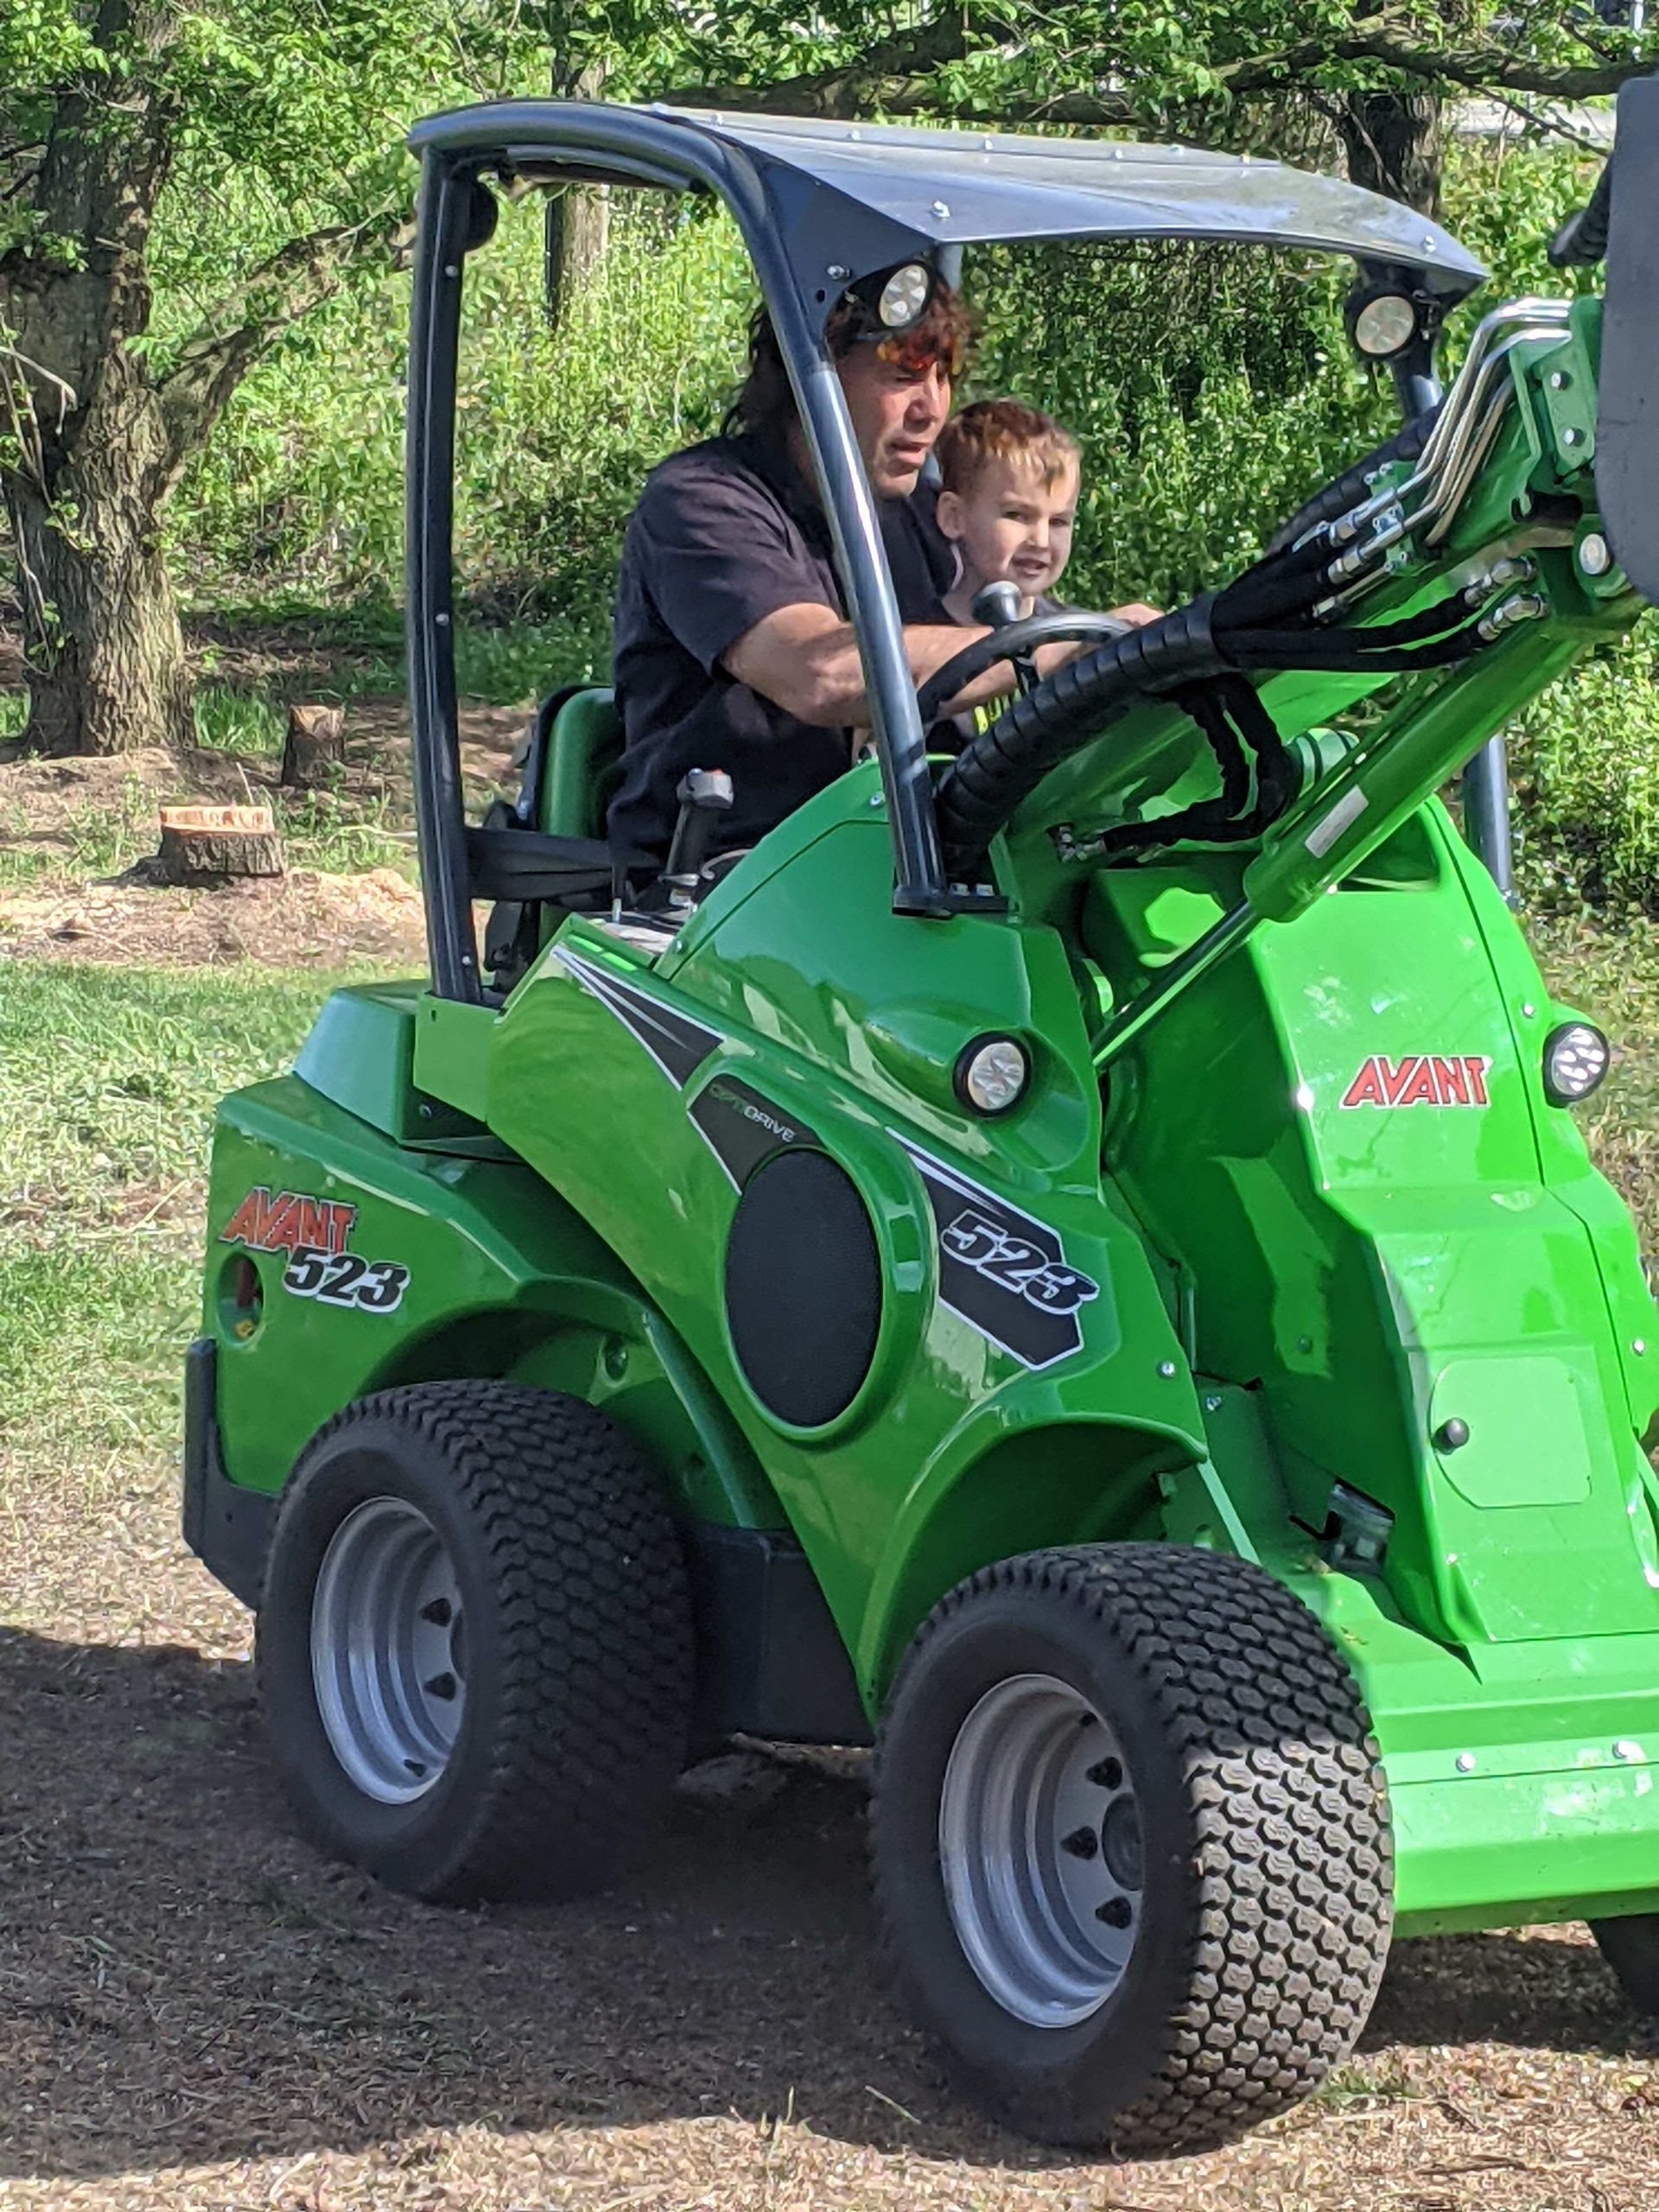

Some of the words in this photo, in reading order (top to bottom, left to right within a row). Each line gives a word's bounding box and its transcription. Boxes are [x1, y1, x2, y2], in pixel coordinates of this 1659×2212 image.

[1340, 1056, 1491, 1108] AVANT
[219, 1186, 356, 1255] AVANT
[283, 1244, 410, 1312] 523
[940, 1210, 1100, 1315] 523
